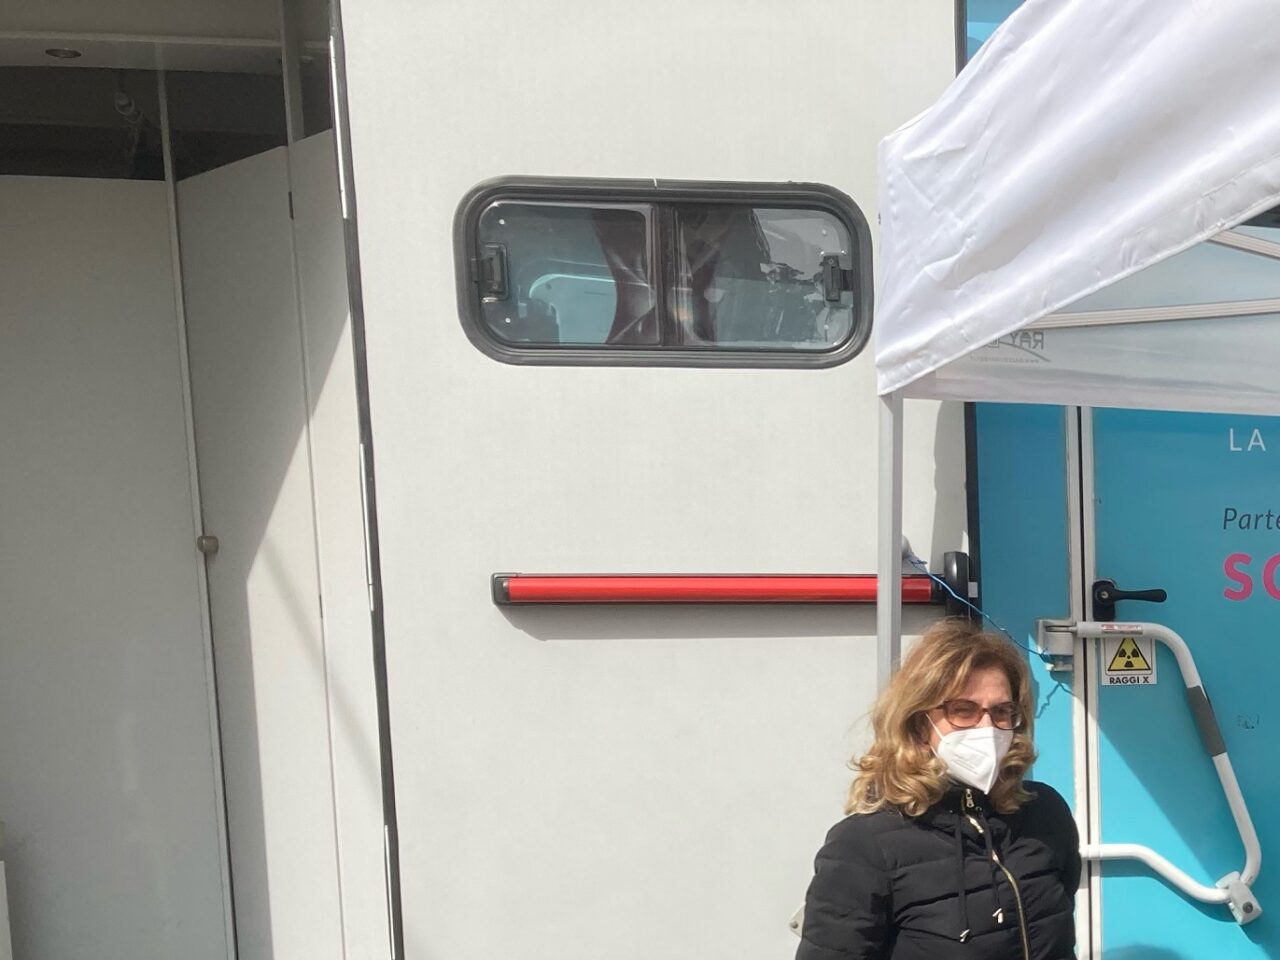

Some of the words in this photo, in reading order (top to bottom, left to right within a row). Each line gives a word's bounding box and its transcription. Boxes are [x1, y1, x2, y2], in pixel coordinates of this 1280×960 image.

[1228, 428, 1266, 452] LA
[1109, 676, 1140, 685] RAGGI
[1142, 676, 1150, 684] X
